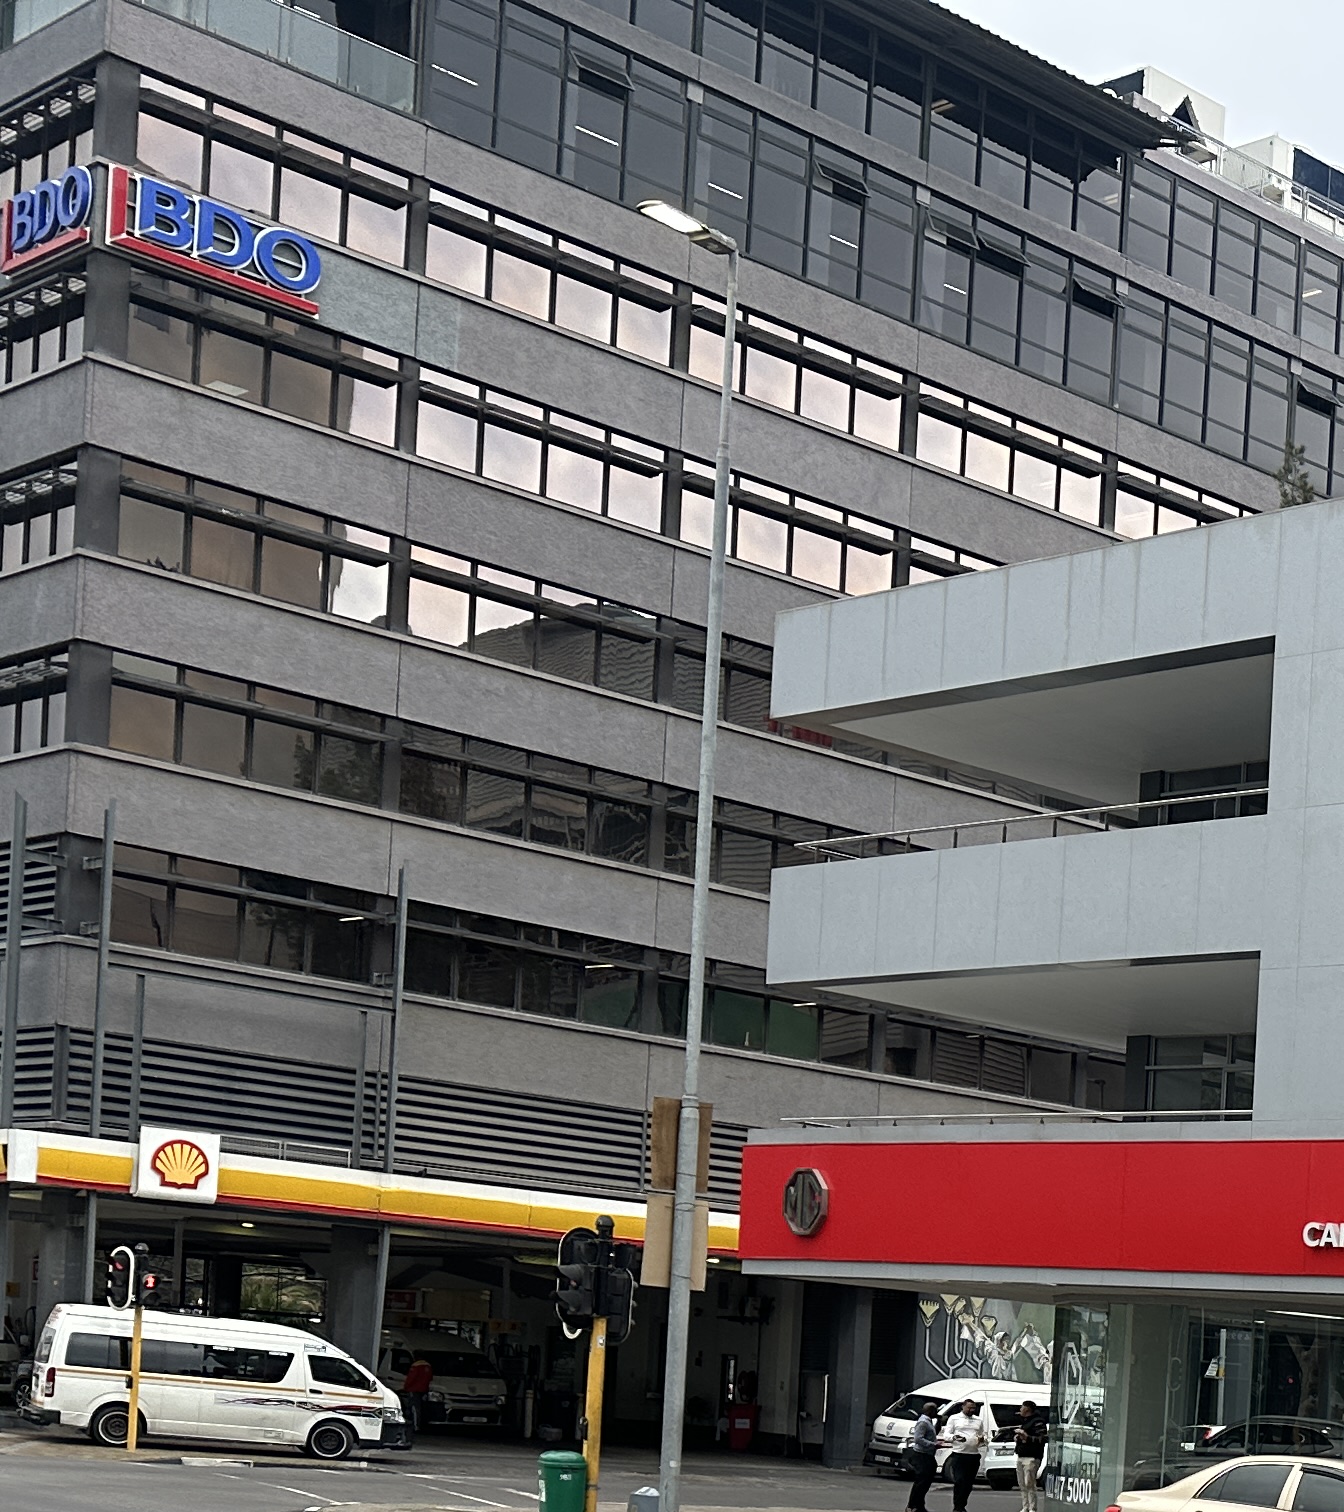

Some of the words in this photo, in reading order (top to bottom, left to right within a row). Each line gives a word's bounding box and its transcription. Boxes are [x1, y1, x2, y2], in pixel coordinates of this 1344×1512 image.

[12, 166, 92, 254] BDO
[135, 173, 321, 294] BDO
[1066, 1477, 1092, 1504] 5000
